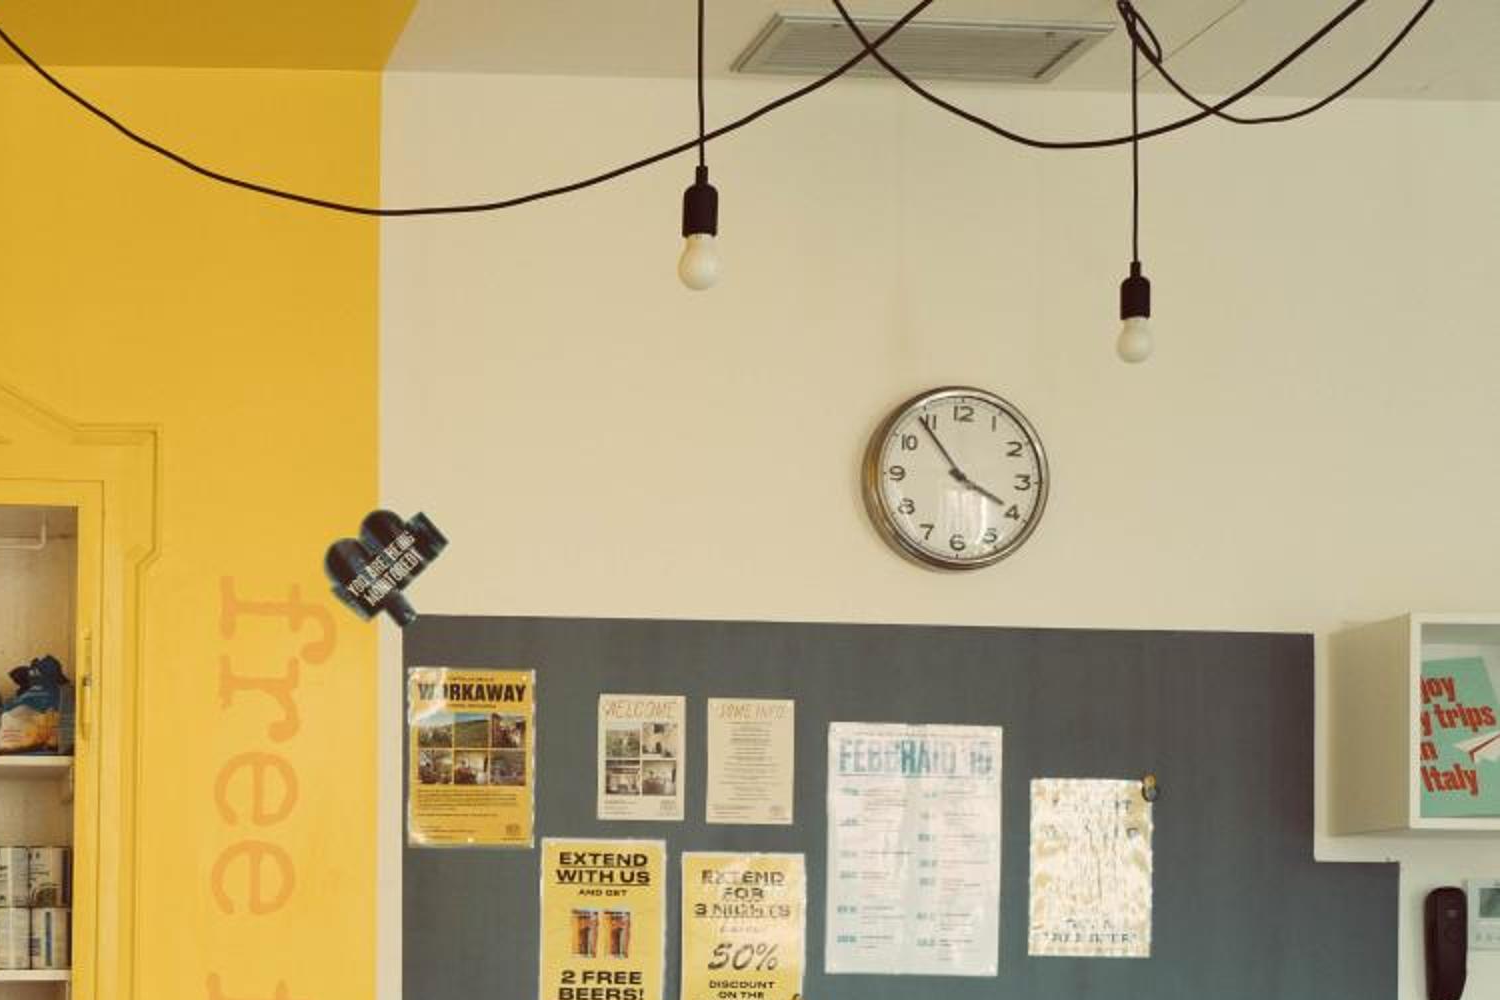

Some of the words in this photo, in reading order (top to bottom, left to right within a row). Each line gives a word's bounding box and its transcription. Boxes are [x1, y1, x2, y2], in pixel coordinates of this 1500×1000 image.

[953, 405, 974, 422] 12
[991, 416, 997, 432] 1
[901, 434, 918, 450] 10
[1006, 441, 1023, 457] 2
[889, 465, 906, 482] 9
[1014, 473, 1031, 491] 3
[898, 498, 916, 515] 8
[1004, 505, 1020, 521] 4
[919, 523, 934, 540] 7
[983, 528, 998, 544] 5
[950, 534, 966, 551] 6
[348, 574, 370, 597] YOU
[365, 555, 388, 579] ARE
[384, 529, 416, 560] BEING
[1434, 704, 1496, 732] trips
[210, 575, 338, 916] free
[1420, 763, 1478, 796] Italy
[559, 852, 648, 867] EXTEND
[556, 869, 614, 883] WITH
[619, 870, 650, 884] US
[723, 887, 765, 899] FOR
[695, 903, 707, 915] 3
[708, 943, 779, 971] 50%
[561, 970, 576, 984] 2
[582, 971, 642, 984] FREE
[709, 980, 775, 989] DISCOUNT
[718, 991, 736, 999] ON
[740, 991, 765, 999] THE
